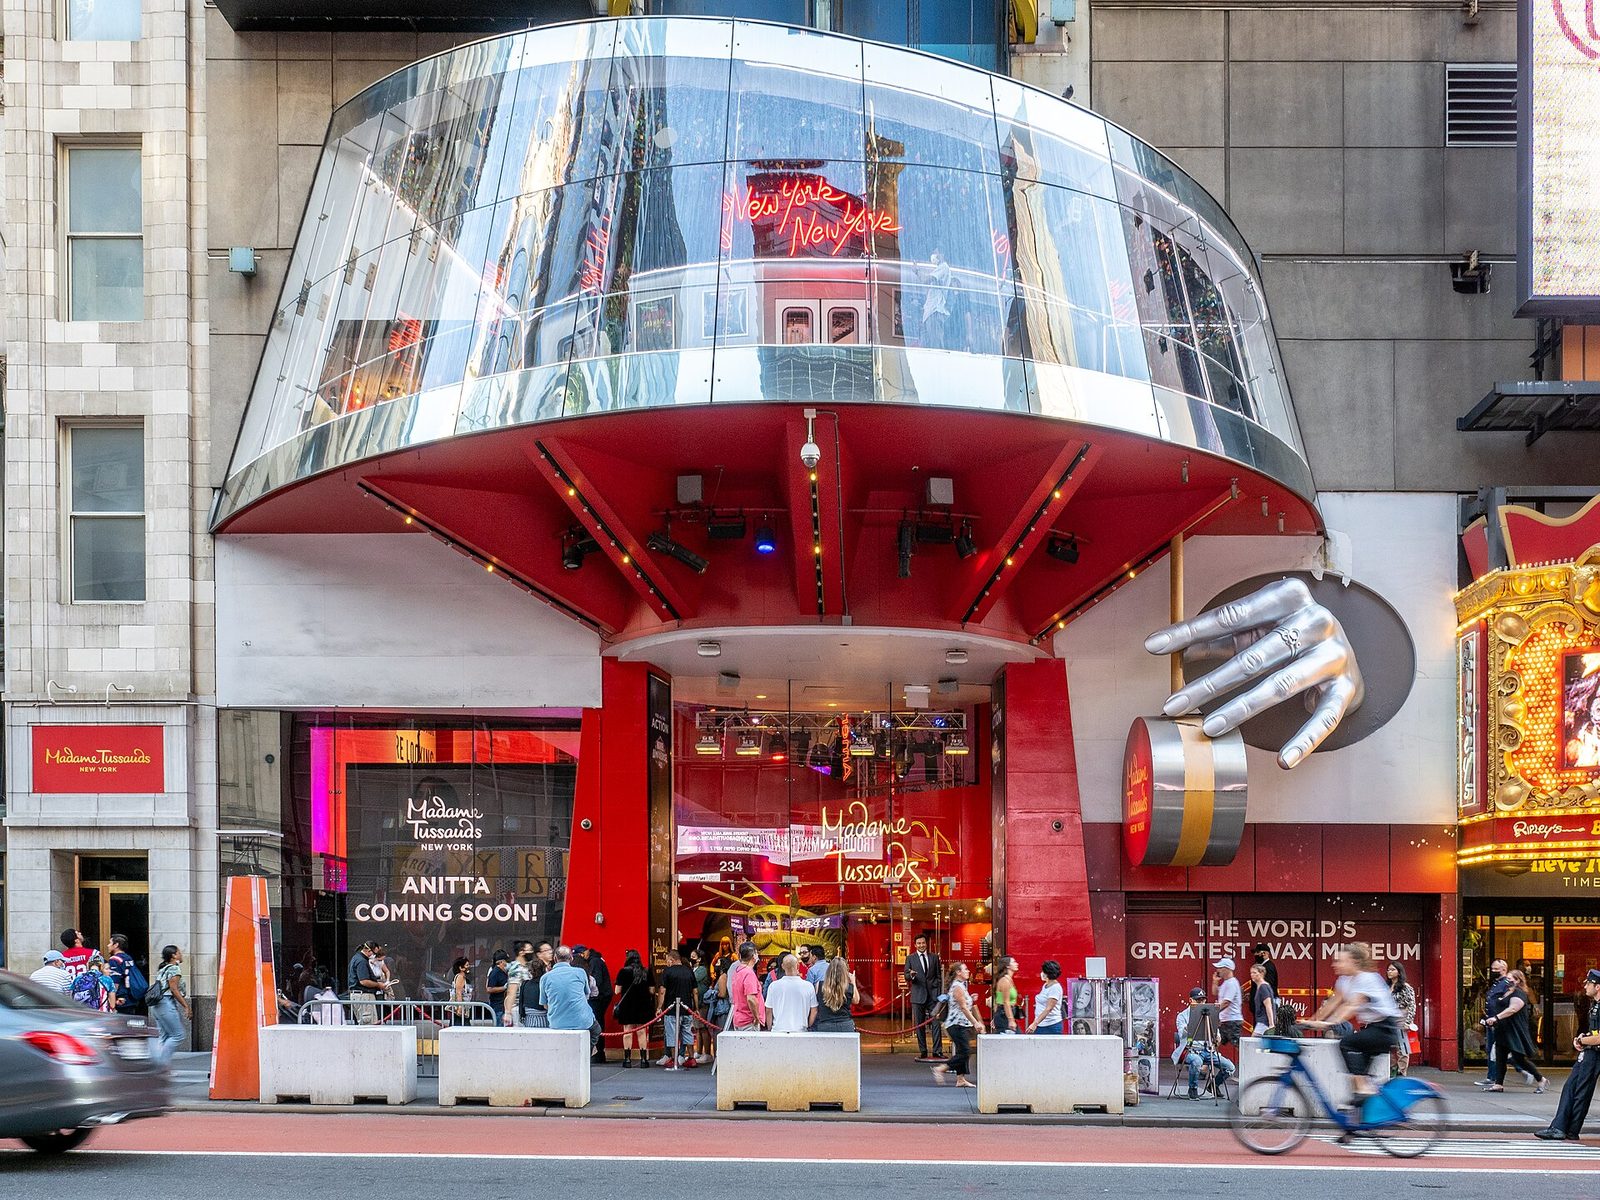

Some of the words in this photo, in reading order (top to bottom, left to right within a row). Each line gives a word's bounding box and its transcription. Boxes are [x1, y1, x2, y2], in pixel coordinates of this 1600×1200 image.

[734, 184, 779, 221] New
[778, 177, 847, 234] York
[790, 211, 840, 256] New
[831, 201, 903, 255] York
[45, 746, 100, 764] Madame
[96, 748, 151, 764] Tussauds
[1126, 753, 1149, 787] Madame
[406, 796, 484, 820] Madame
[1126, 784, 1148, 819] Tussauds
[406, 818, 483, 840] Tussauds
[822, 801, 913, 844] Madame
[1137, 821, 1145, 832] YORK
[421, 843, 445, 851] NEW
[446, 843, 473, 851] YORK
[719, 860, 744, 873] 234
[824, 841, 921, 896] Tussauds
[401, 876, 491, 894] ANITTA
[354, 903, 453, 922] COMING
[459, 903, 538, 922] SOON!
[1194, 920, 1239, 937] THE
[1247, 920, 1357, 938] WORLD'S
[1130, 942, 1250, 960] GREATEST
[1321, 942, 1421, 960] MEUM
